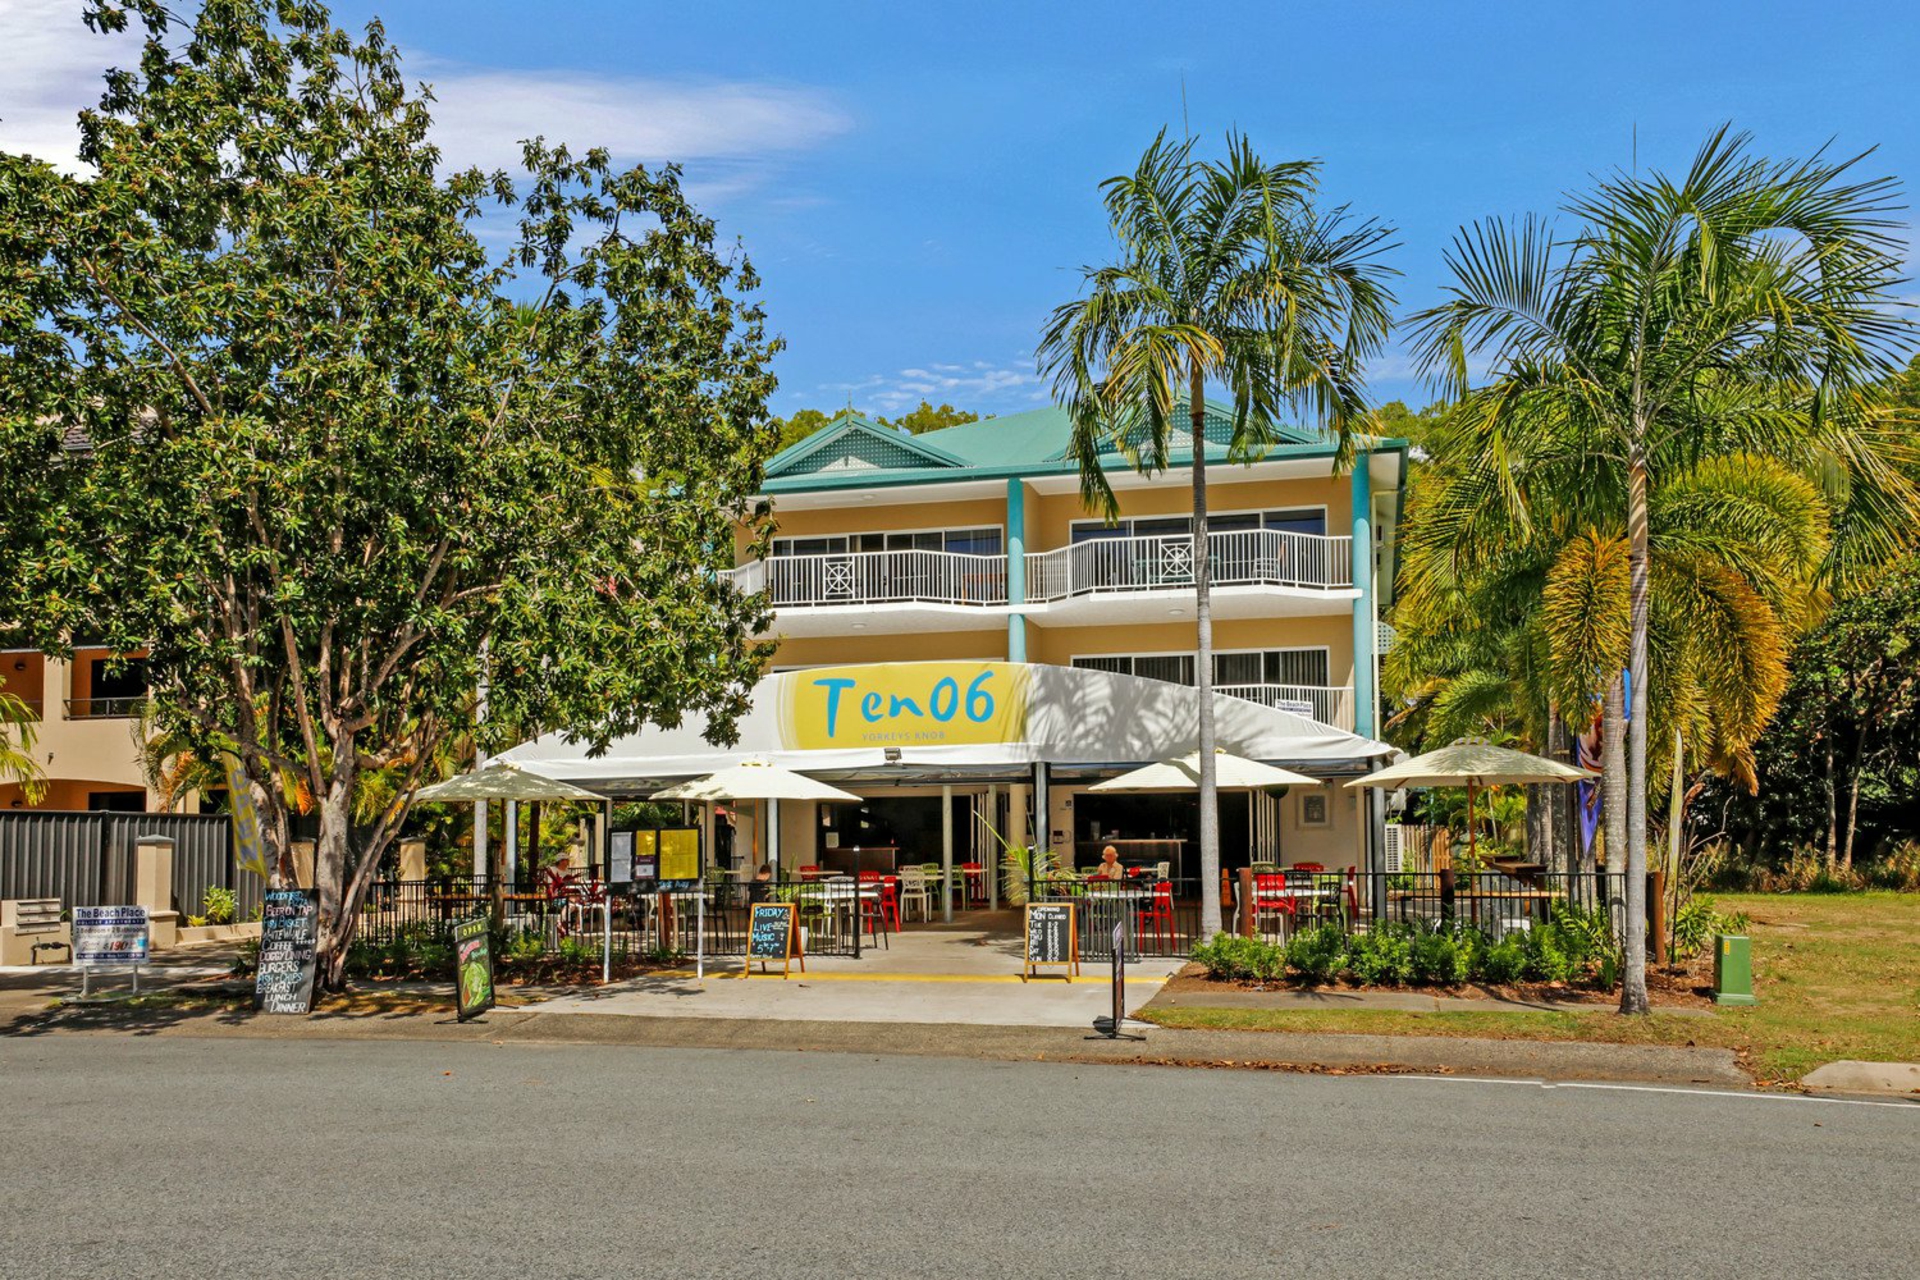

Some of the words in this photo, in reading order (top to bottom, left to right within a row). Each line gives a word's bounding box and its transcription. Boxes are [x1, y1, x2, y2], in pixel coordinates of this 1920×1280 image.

[862, 733, 911, 742] YORKEYS
[914, 732, 946, 740] KNOB
[231, 769, 258, 862] OPEN
[76, 908, 92, 918] The
[93, 908, 120, 918] Beach
[121, 907, 145, 918] Place
[266, 904, 284, 916] BEER
[298, 905, 313, 916] TAP
[1029, 910, 1046, 920] MON
[462, 924, 482, 936] OPEN
[754, 922, 772, 932] LIVE
[262, 939, 294, 951] COFFEE
[258, 961, 300, 974] BURGERS
[280, 972, 303, 983] CHIPS
[264, 993, 297, 1002] LUNCH
[270, 1002, 306, 1013] DINNER
